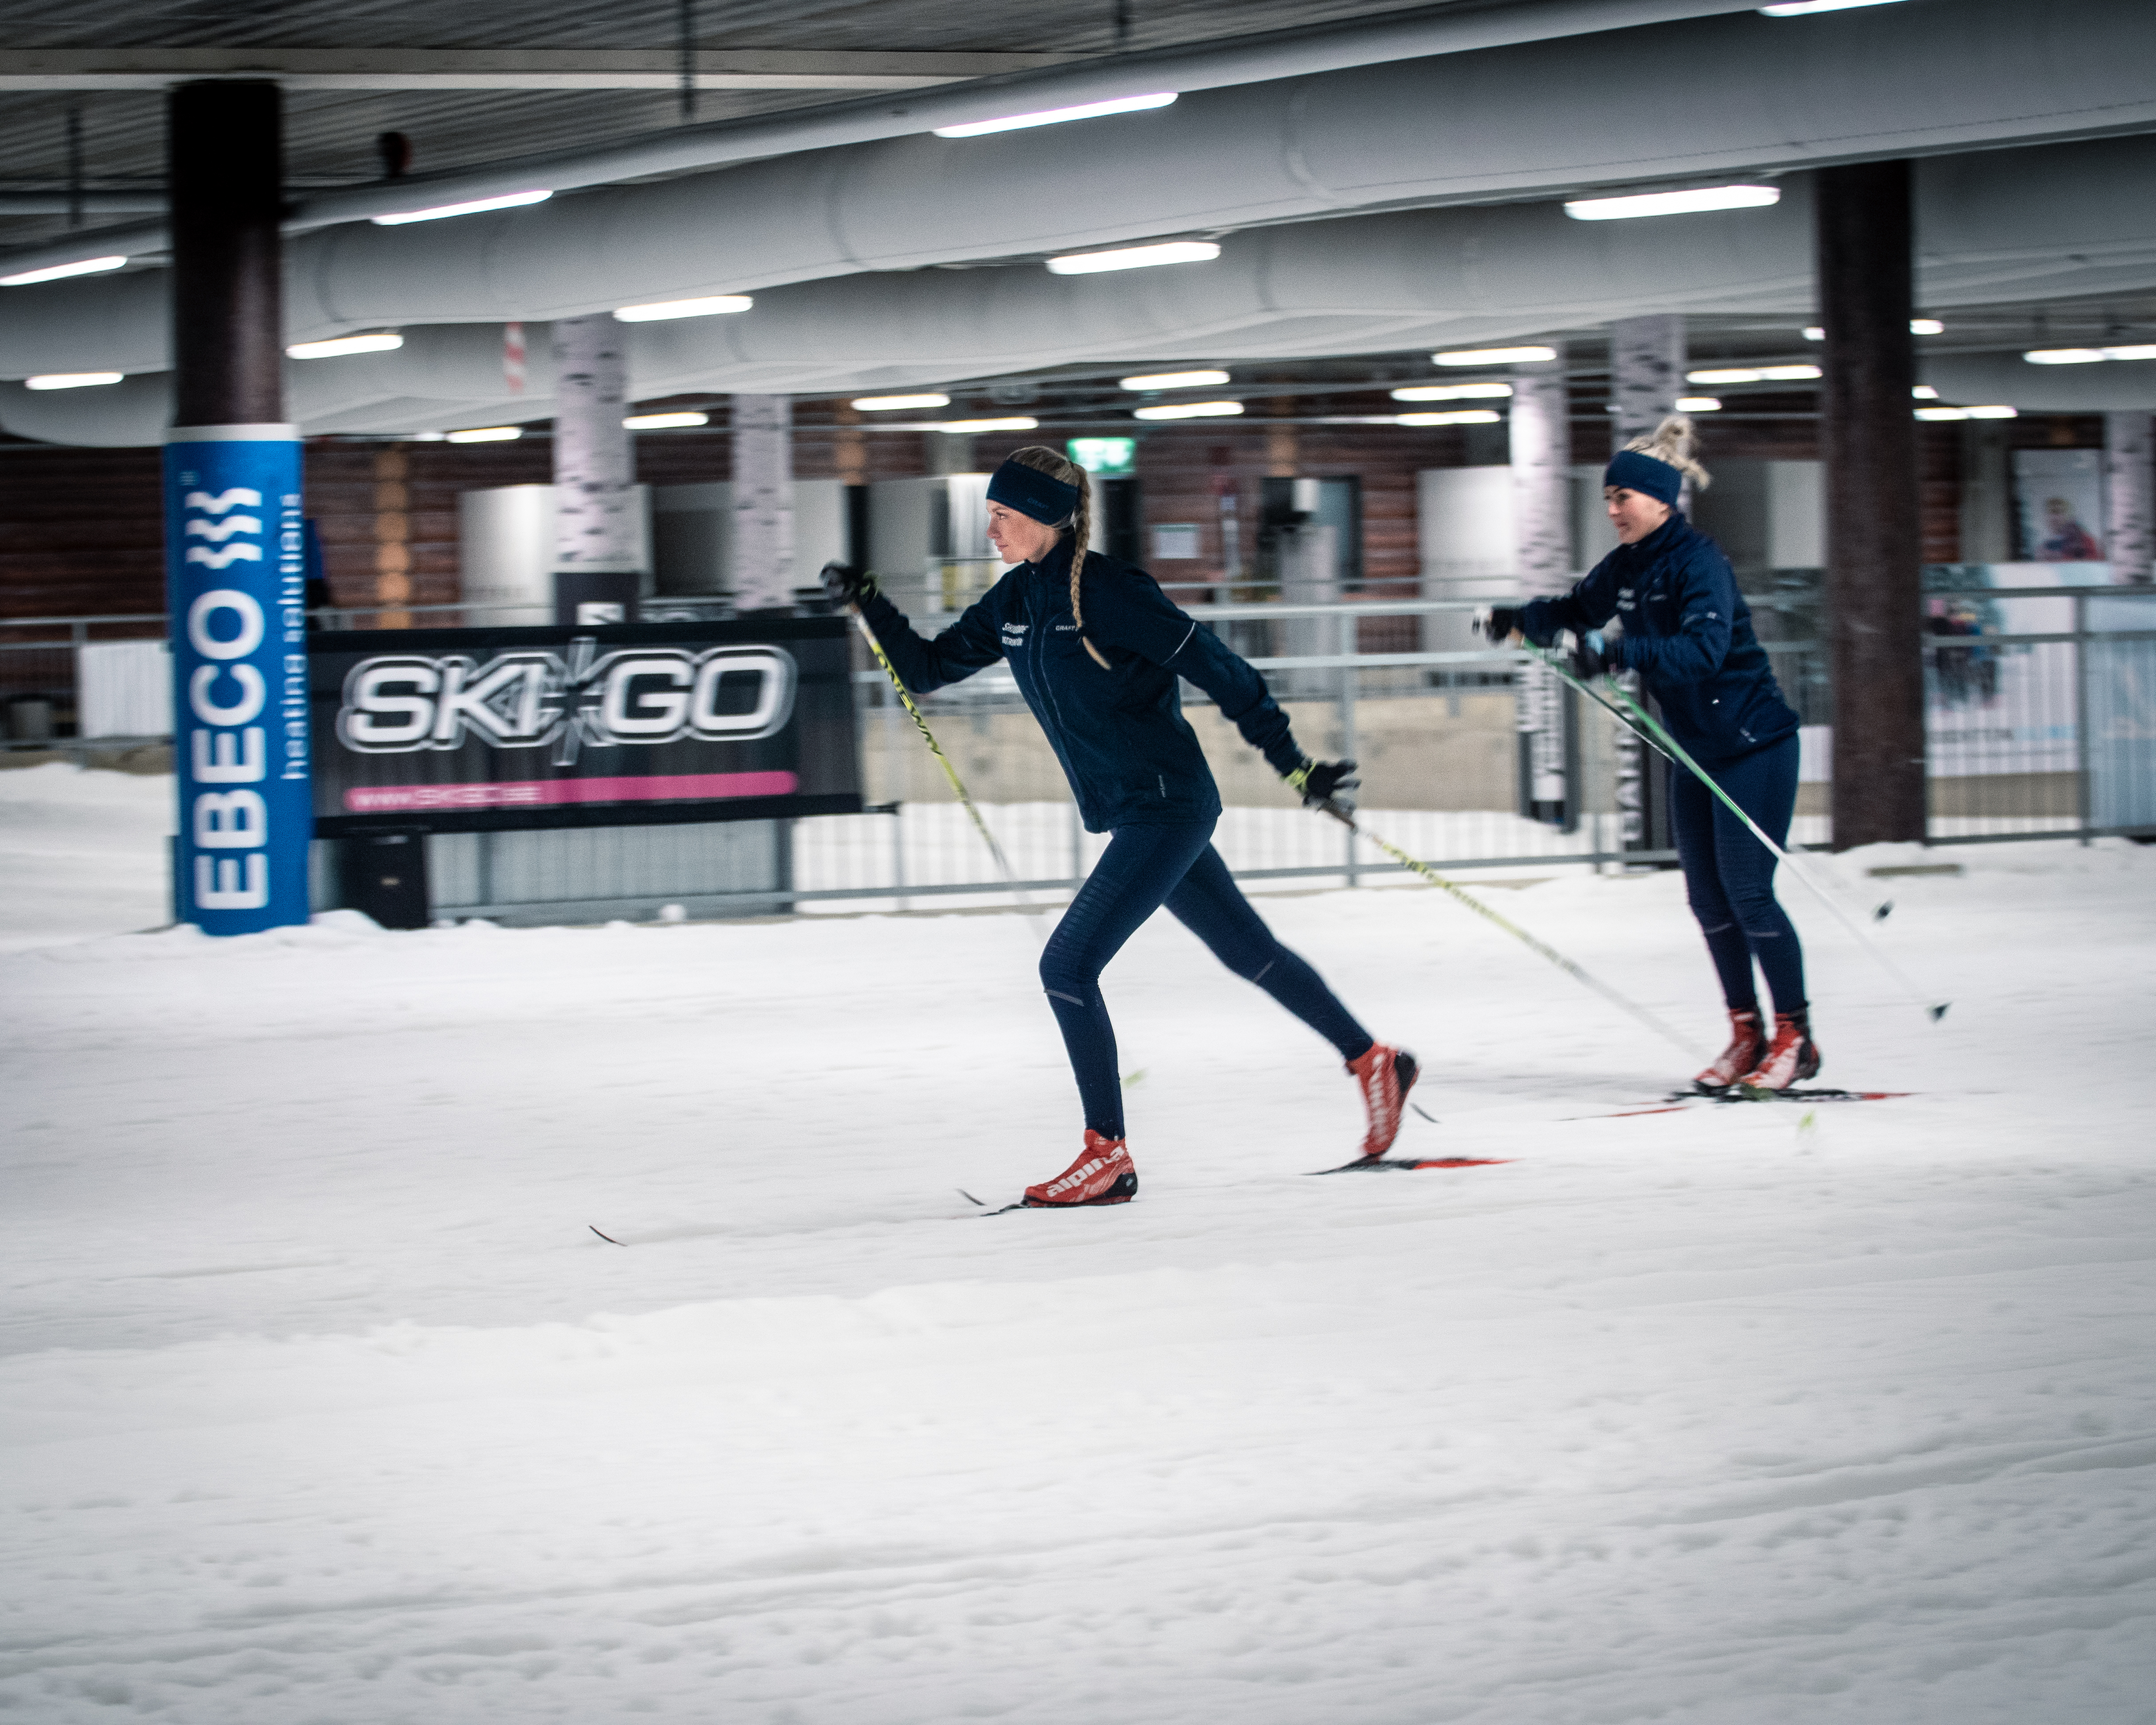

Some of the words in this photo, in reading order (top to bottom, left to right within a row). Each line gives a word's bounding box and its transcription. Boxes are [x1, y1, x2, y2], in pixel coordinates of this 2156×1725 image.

[277, 493, 304, 643] solutions
[188, 589, 268, 910] EBECO
[280, 654, 308, 780] heating
